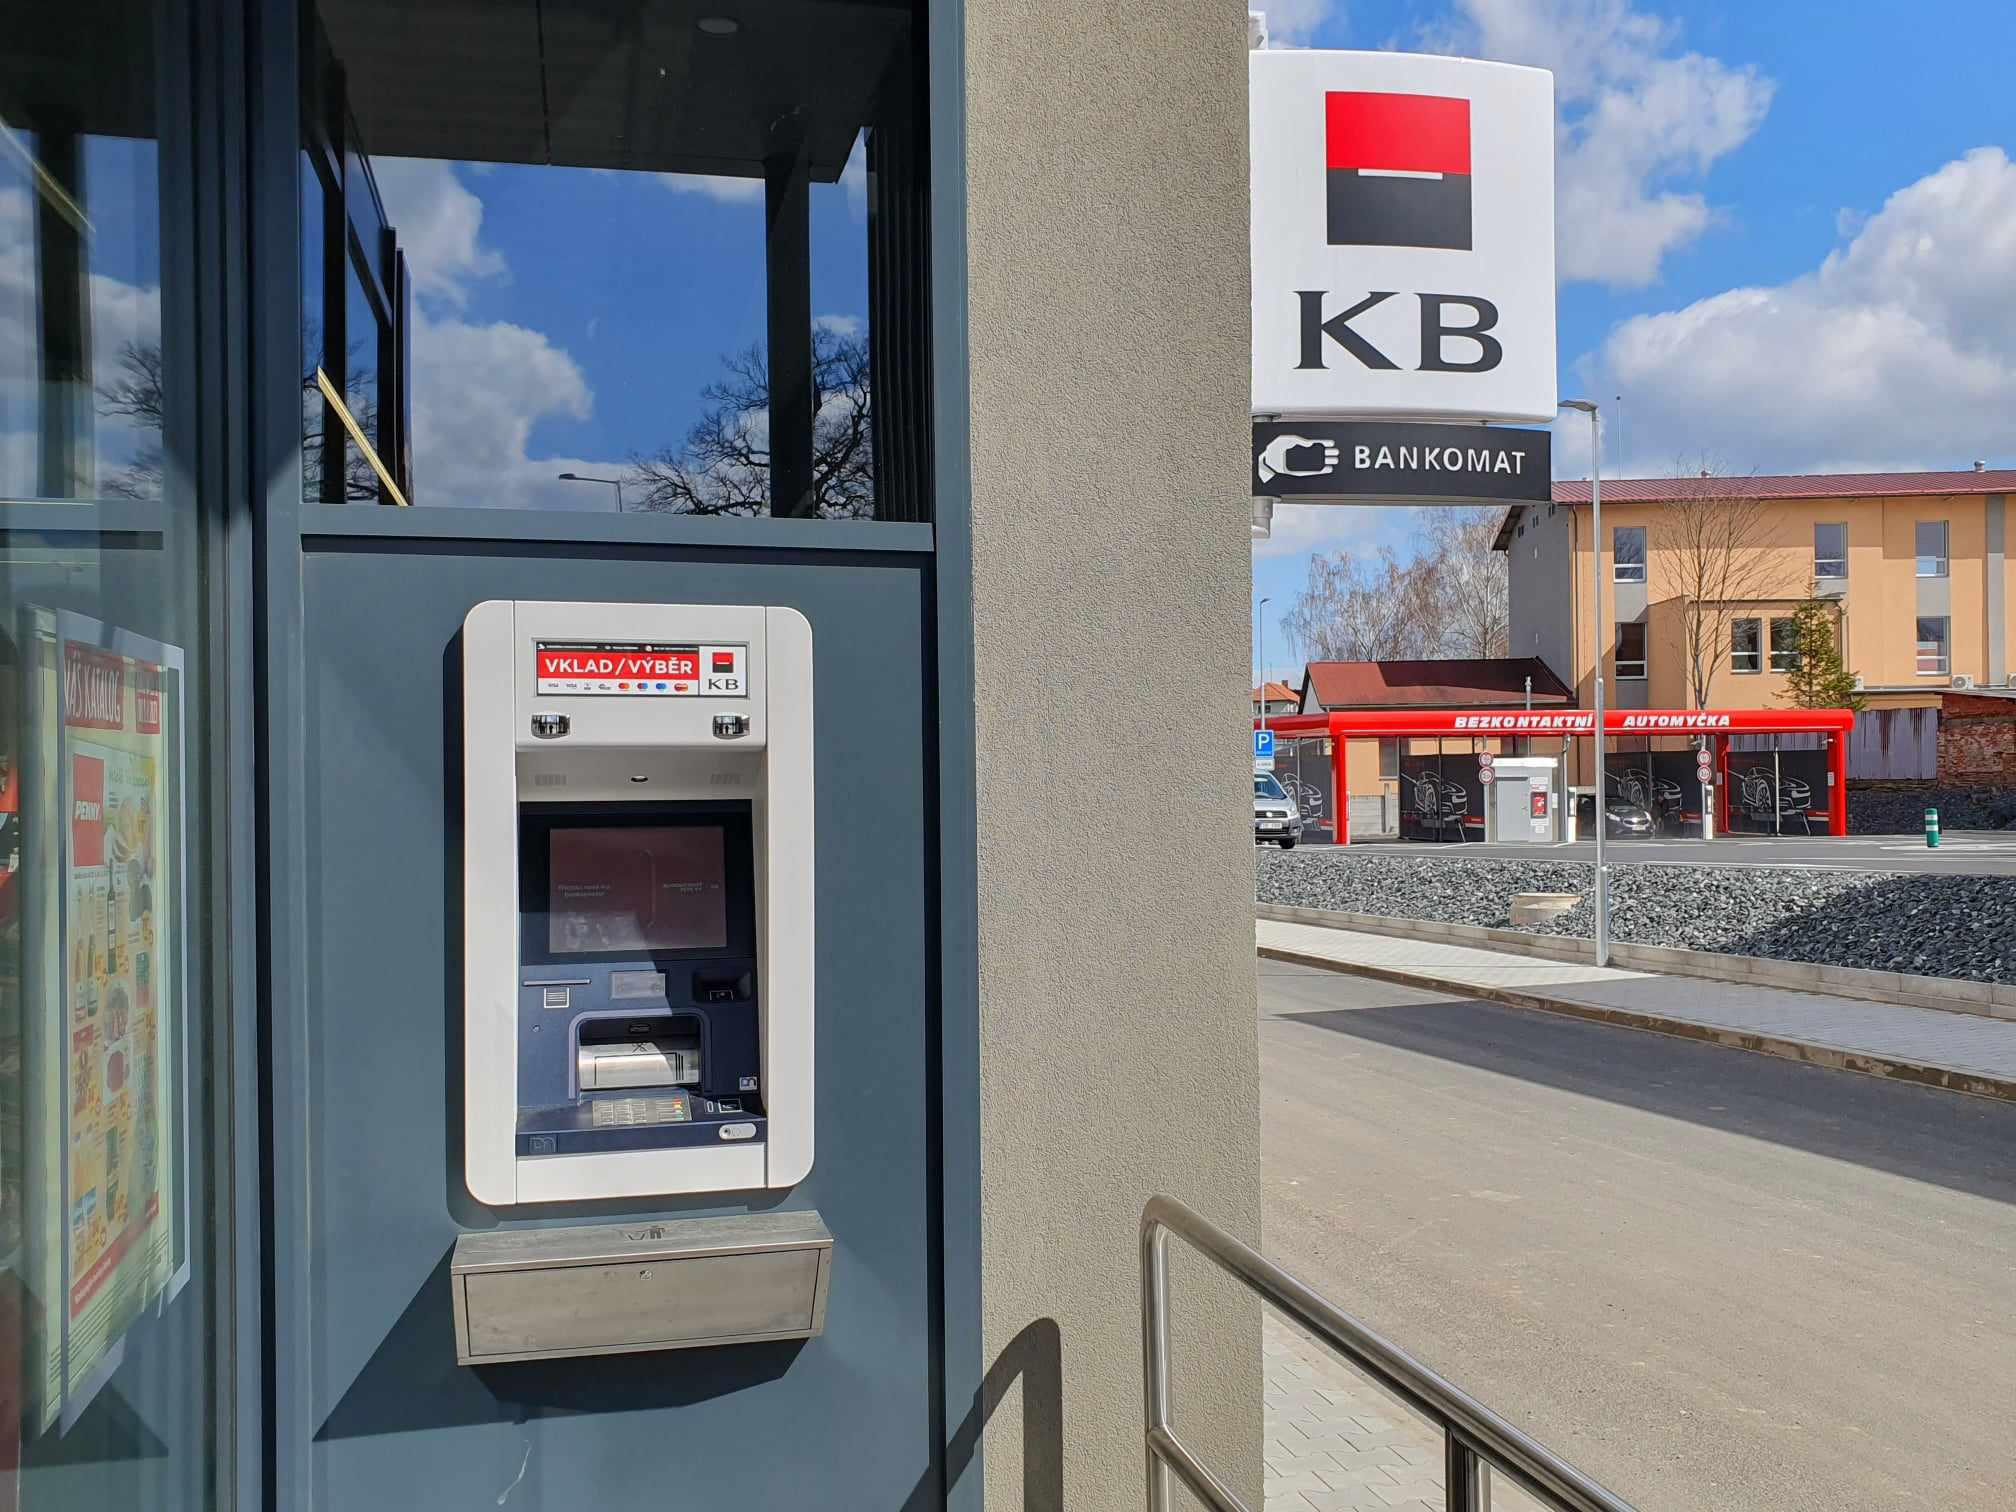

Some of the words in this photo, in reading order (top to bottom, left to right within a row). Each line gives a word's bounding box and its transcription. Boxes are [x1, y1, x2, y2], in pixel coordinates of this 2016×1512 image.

[1292, 290, 1503, 373] KB
[1354, 445, 1526, 475] BANKOMAT
[545, 656, 693, 676] VKLAD/VÝBĚR
[84, 663, 121, 723] KATALOG
[707, 678, 739, 691] KB
[1454, 713, 1593, 728] BEZKONTAKTNÍ
[1623, 711, 1730, 727] AUTOMYČKA
[1258, 733, 1270, 750] P
[75, 800, 100, 821] PENNY
